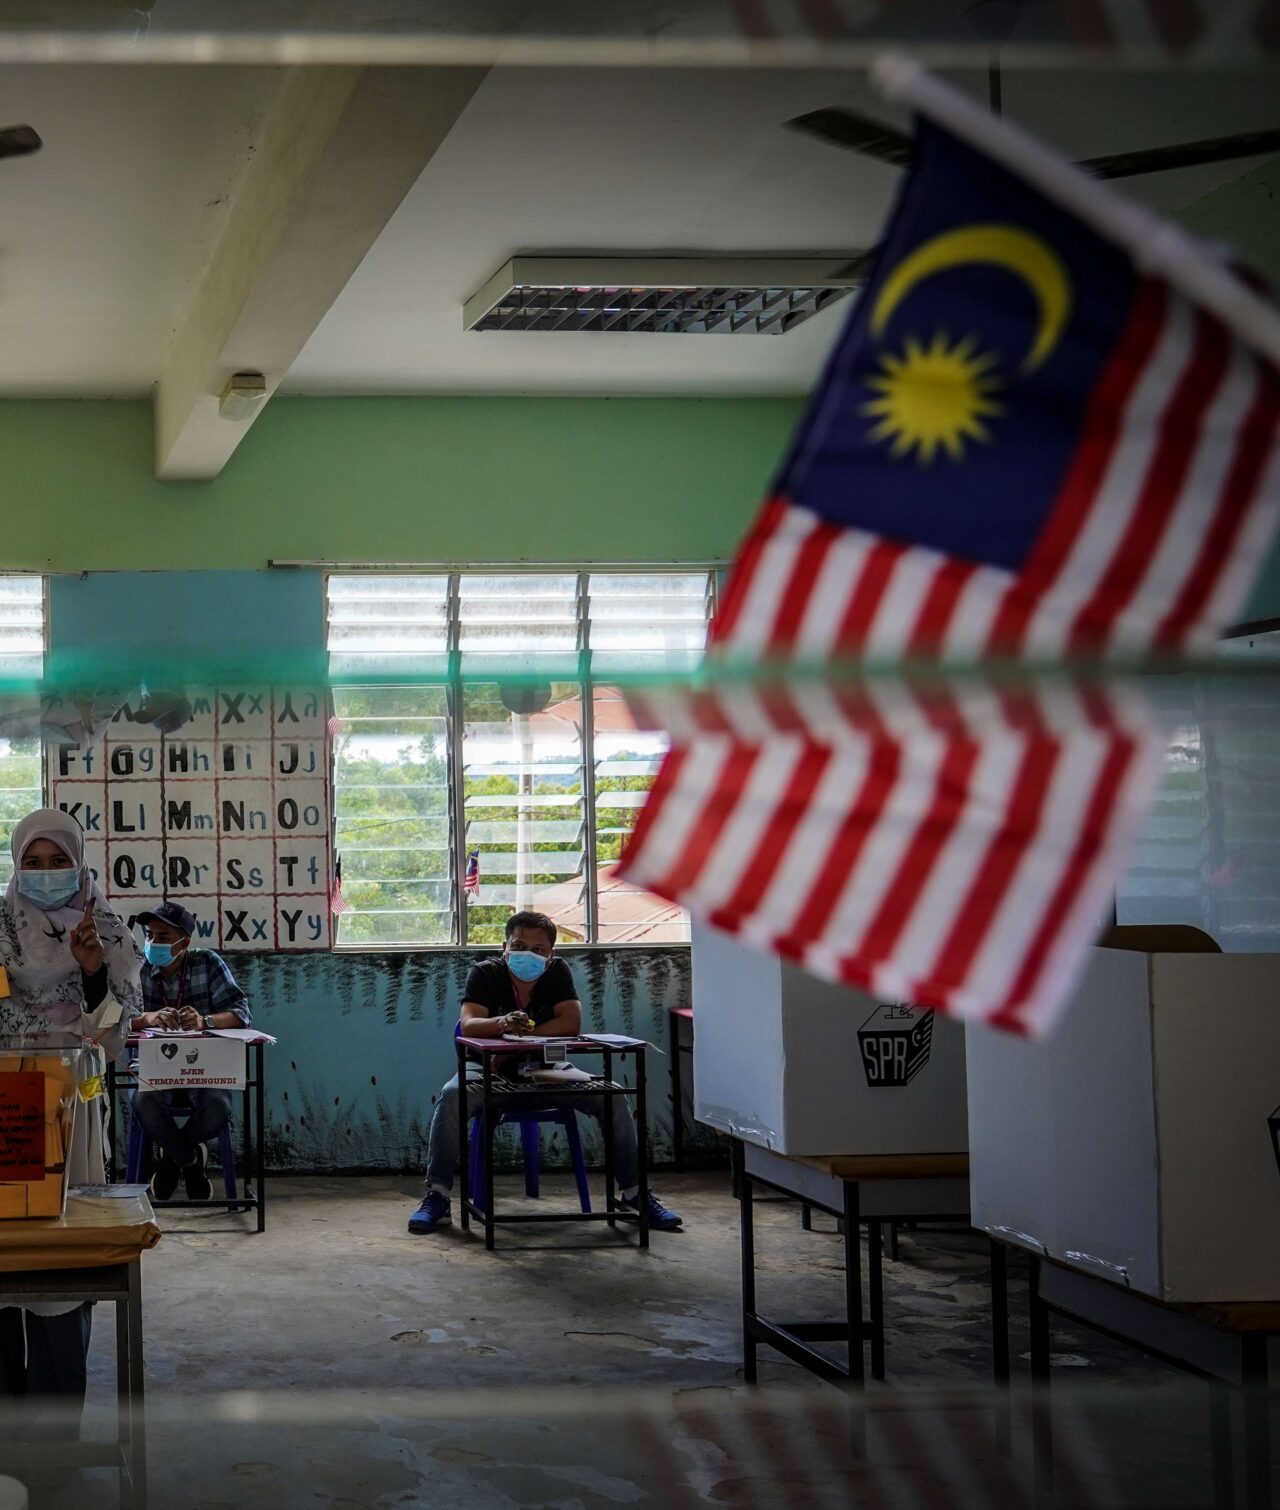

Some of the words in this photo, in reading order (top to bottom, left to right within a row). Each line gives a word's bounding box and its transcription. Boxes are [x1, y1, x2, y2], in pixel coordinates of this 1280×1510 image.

[863, 1037, 907, 1080] SPR
[180, 1068, 205, 1076] EJEN
[148, 1078, 185, 1086] TEMPAT
[186, 1077, 237, 1085] MENGUNDI
